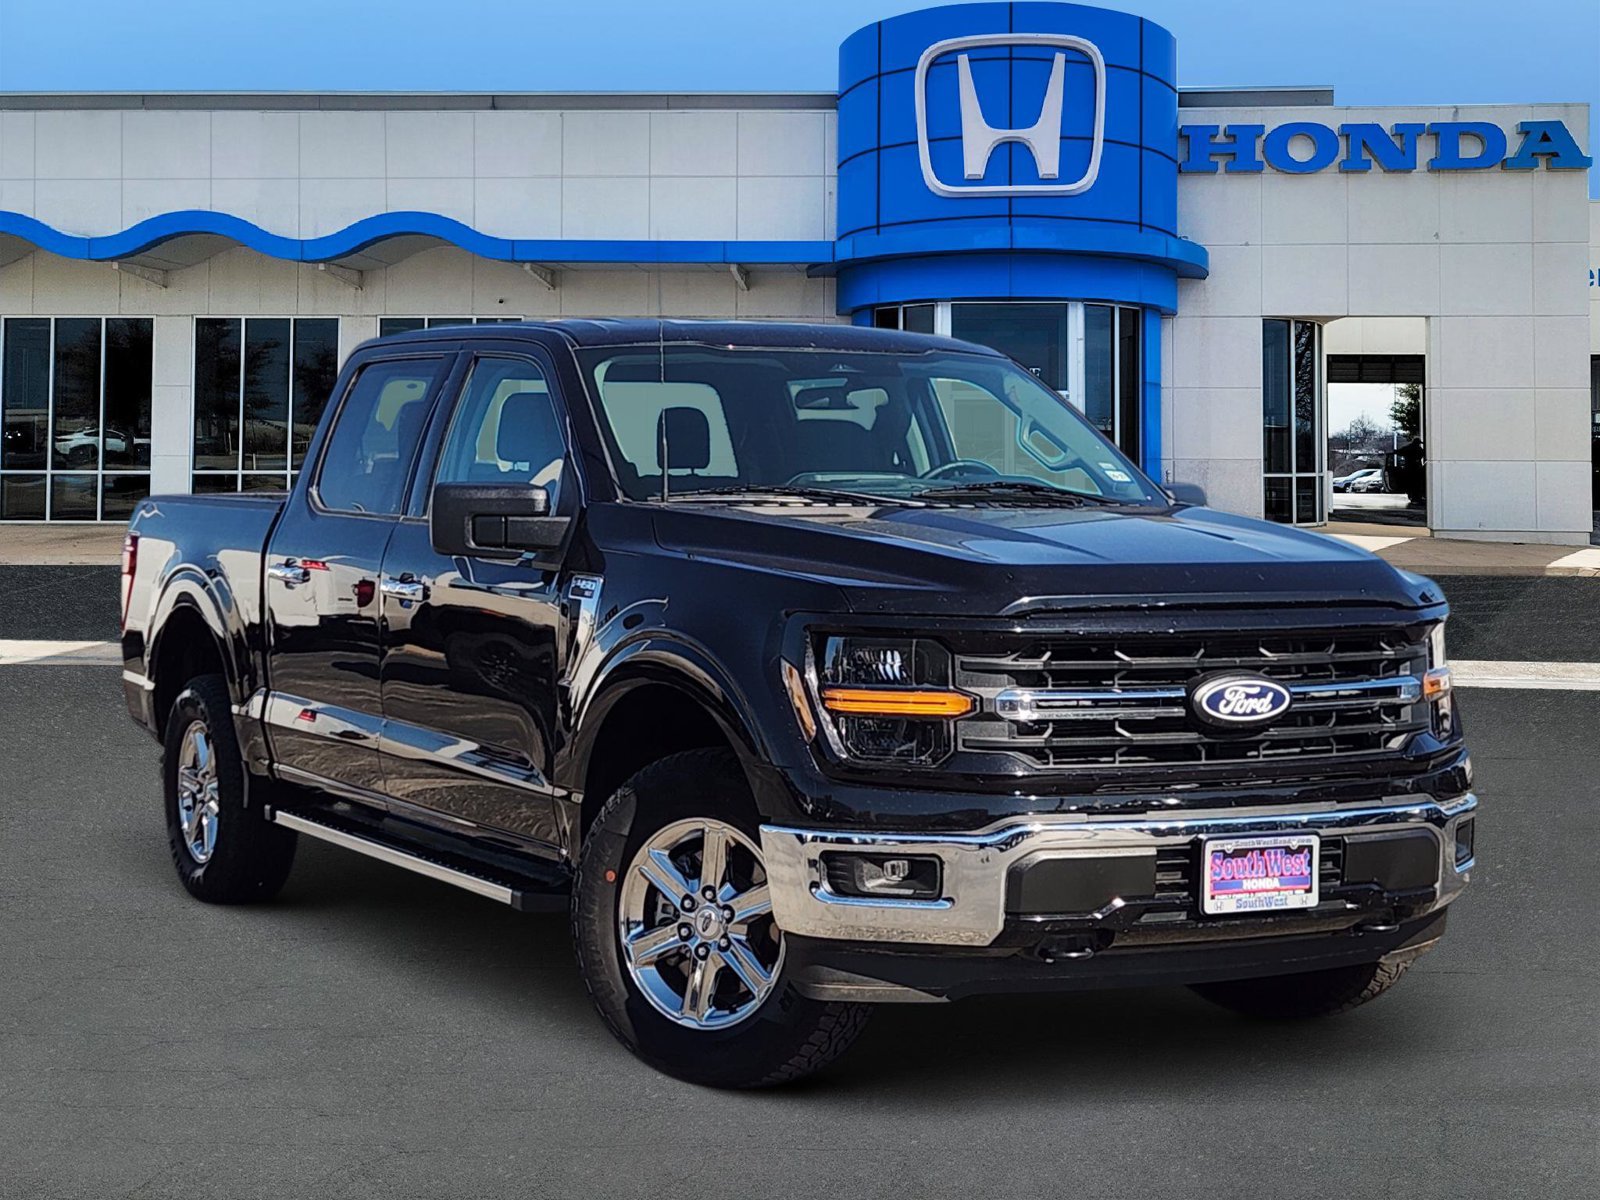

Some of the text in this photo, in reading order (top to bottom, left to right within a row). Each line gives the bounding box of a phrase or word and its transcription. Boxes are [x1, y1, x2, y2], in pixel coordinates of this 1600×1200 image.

[1179, 120, 1593, 174] HONDA
[1219, 686, 1274, 714] Ford
[1210, 847, 1311, 880] SouthWest
[1242, 877, 1281, 891] HONDA
[1235, 896, 1288, 910] SouthWest
